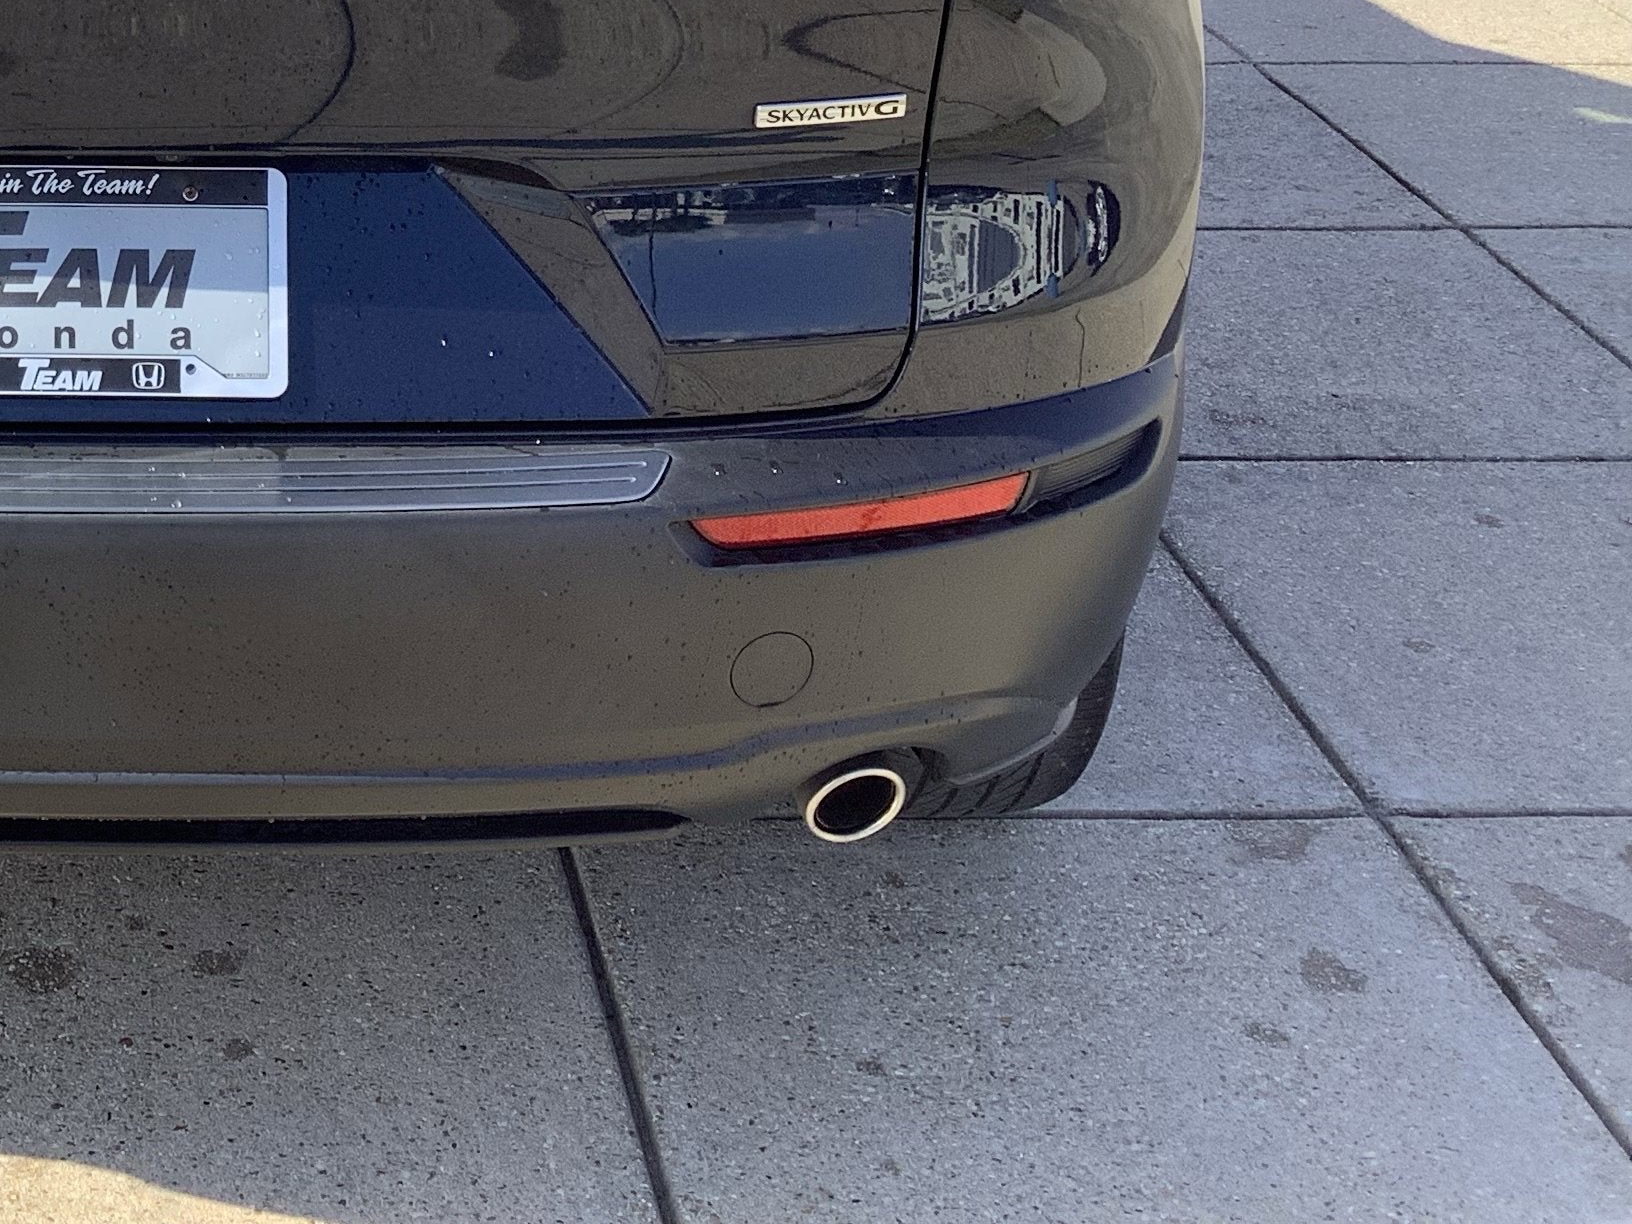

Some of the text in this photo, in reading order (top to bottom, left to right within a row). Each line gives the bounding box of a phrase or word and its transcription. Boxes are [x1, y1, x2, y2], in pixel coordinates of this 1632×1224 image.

[26, 169, 75, 195] The
[77, 169, 160, 196] Team!
[18, 358, 103, 391] TEAM
